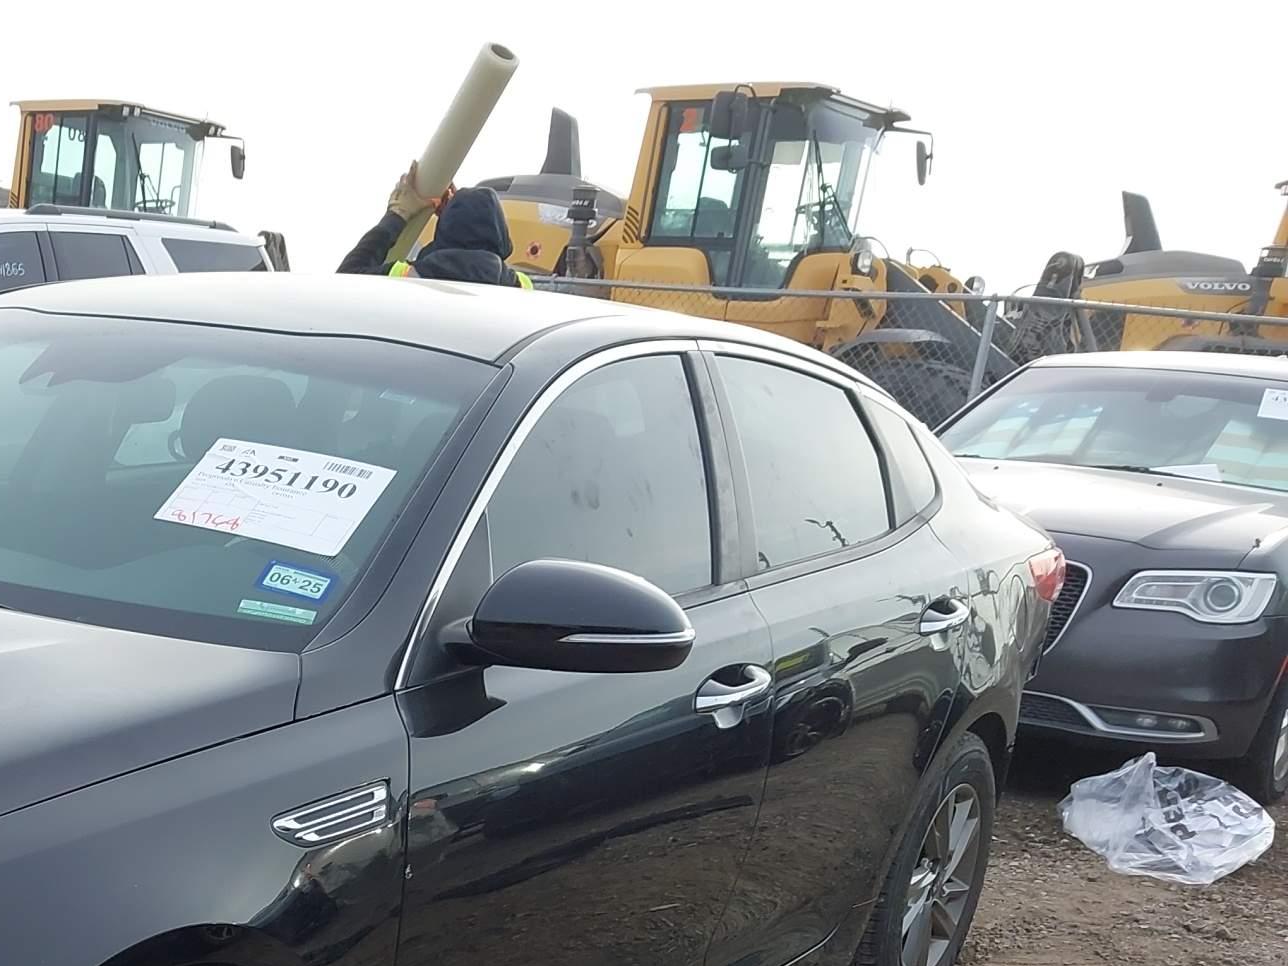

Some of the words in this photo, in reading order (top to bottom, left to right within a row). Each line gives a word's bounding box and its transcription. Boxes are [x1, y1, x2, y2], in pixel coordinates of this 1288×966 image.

[1187, 281, 1251, 291] VOLVO
[215, 458, 357, 499] 43951190
[269, 571, 293, 586] 06
[298, 579, 324, 594] 25
